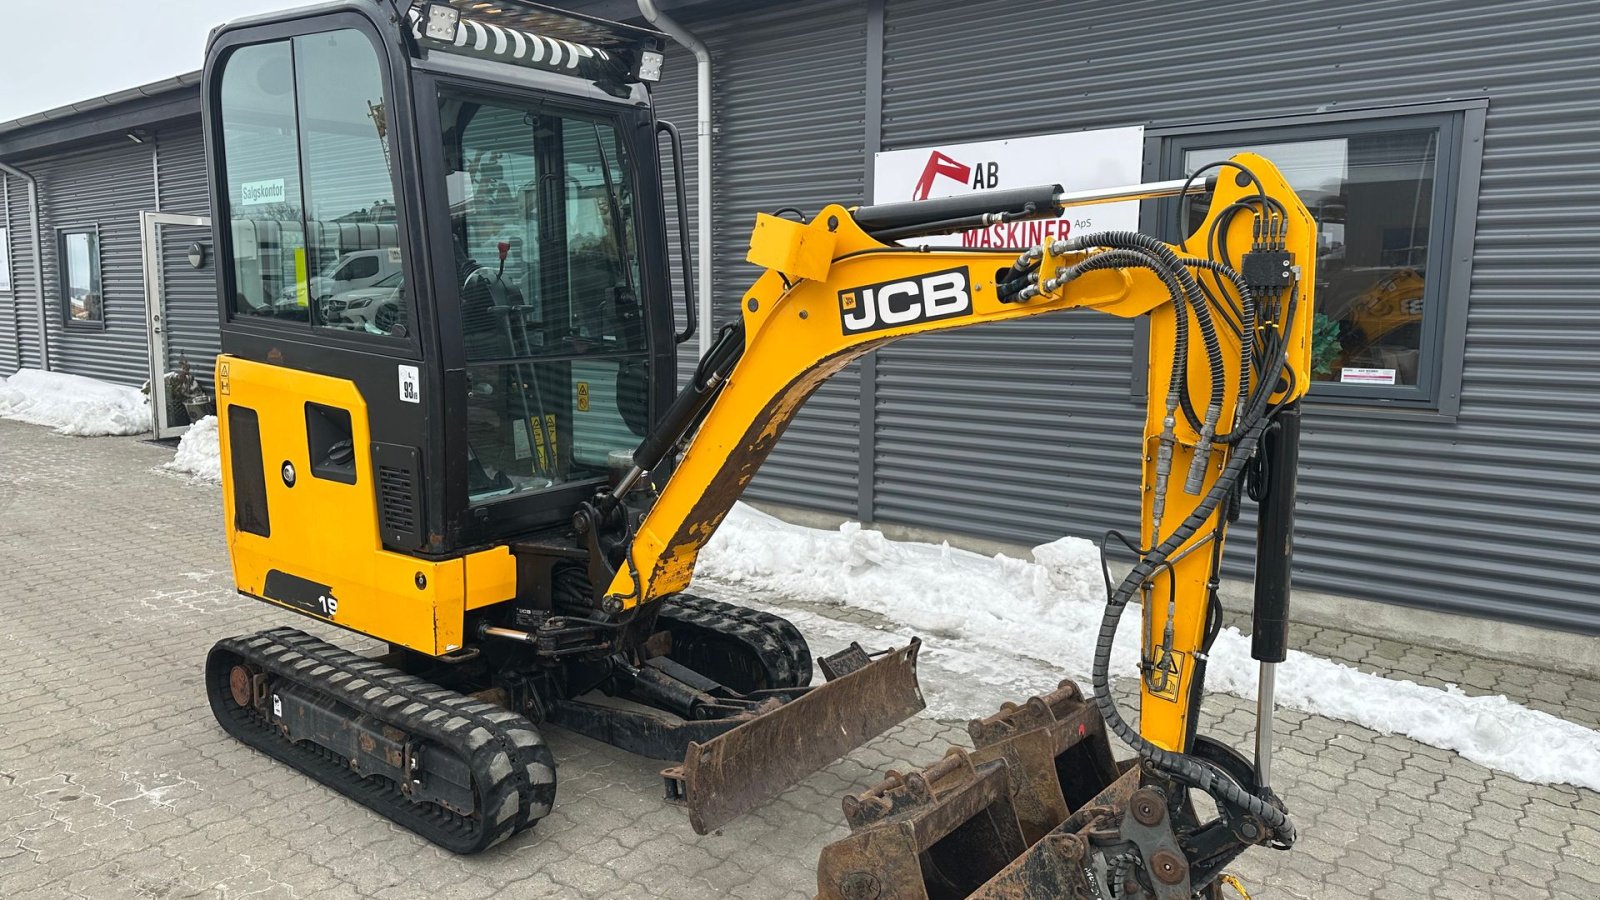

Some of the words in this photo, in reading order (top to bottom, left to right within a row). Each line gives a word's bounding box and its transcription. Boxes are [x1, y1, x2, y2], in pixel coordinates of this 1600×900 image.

[973, 161, 999, 190] AB
[242, 184, 283, 201] Salgskontor
[1074, 218, 1092, 228] ApS
[844, 272, 969, 330] JCB
[318, 595, 338, 616] 19
